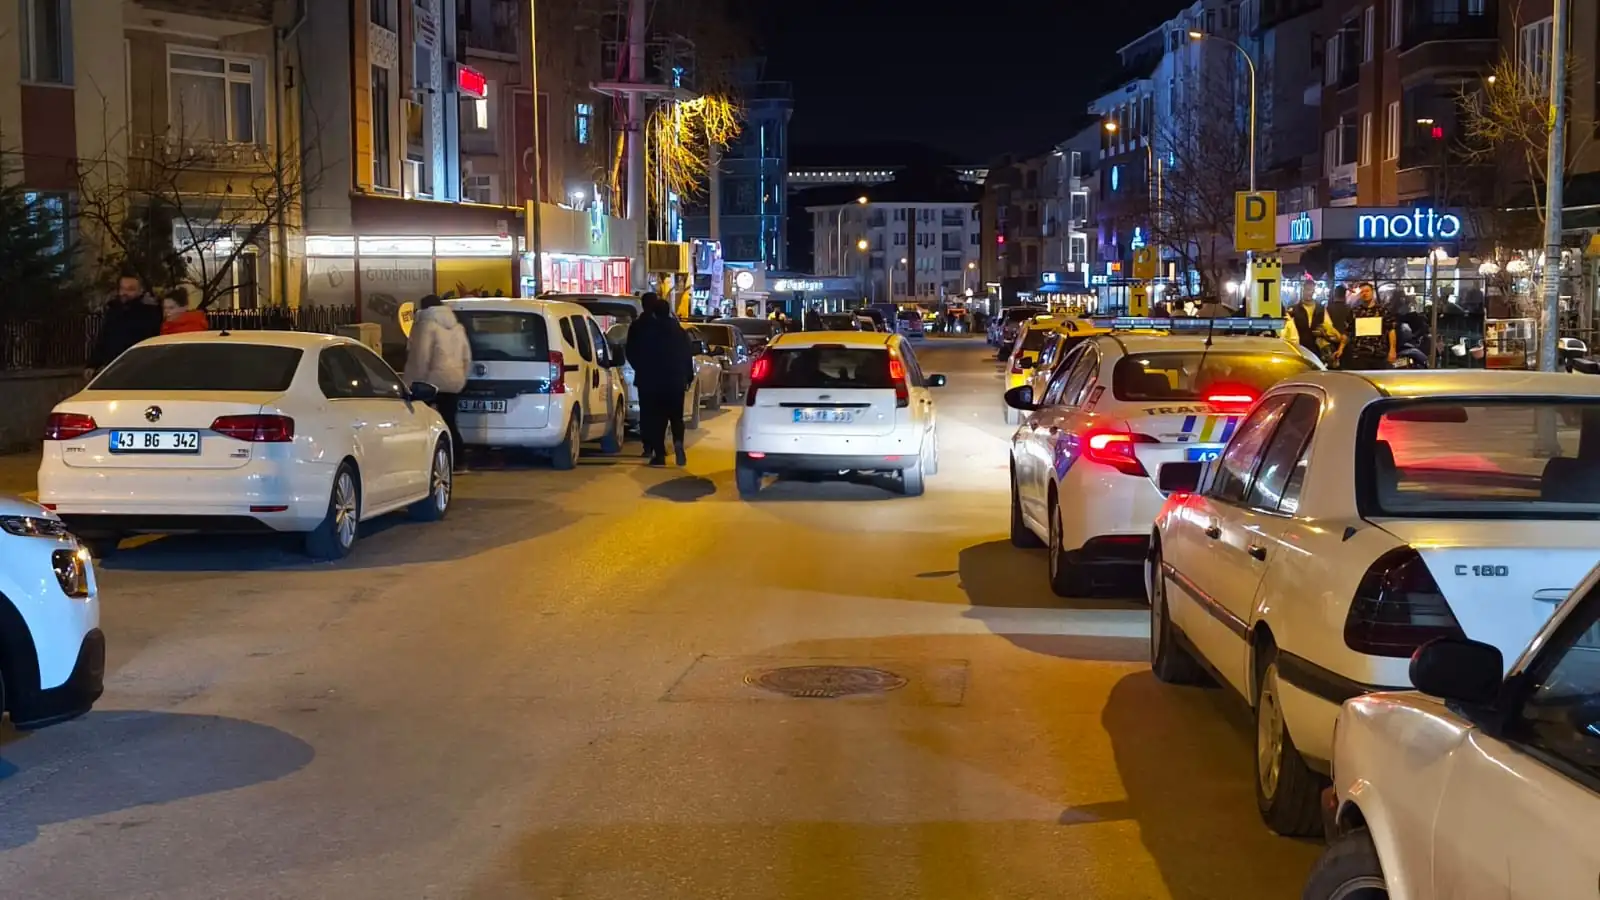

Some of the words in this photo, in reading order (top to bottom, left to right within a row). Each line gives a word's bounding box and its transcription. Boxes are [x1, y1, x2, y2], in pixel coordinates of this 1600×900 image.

[1246, 197, 1266, 221] D
[1291, 212, 1311, 240] motto
[1359, 208, 1460, 238] motto
[118, 433, 134, 448] 43
[144, 433, 160, 448] BG
[172, 433, 196, 448] 342
[1454, 564, 1468, 576] C
[1472, 565, 1509, 576] 180
